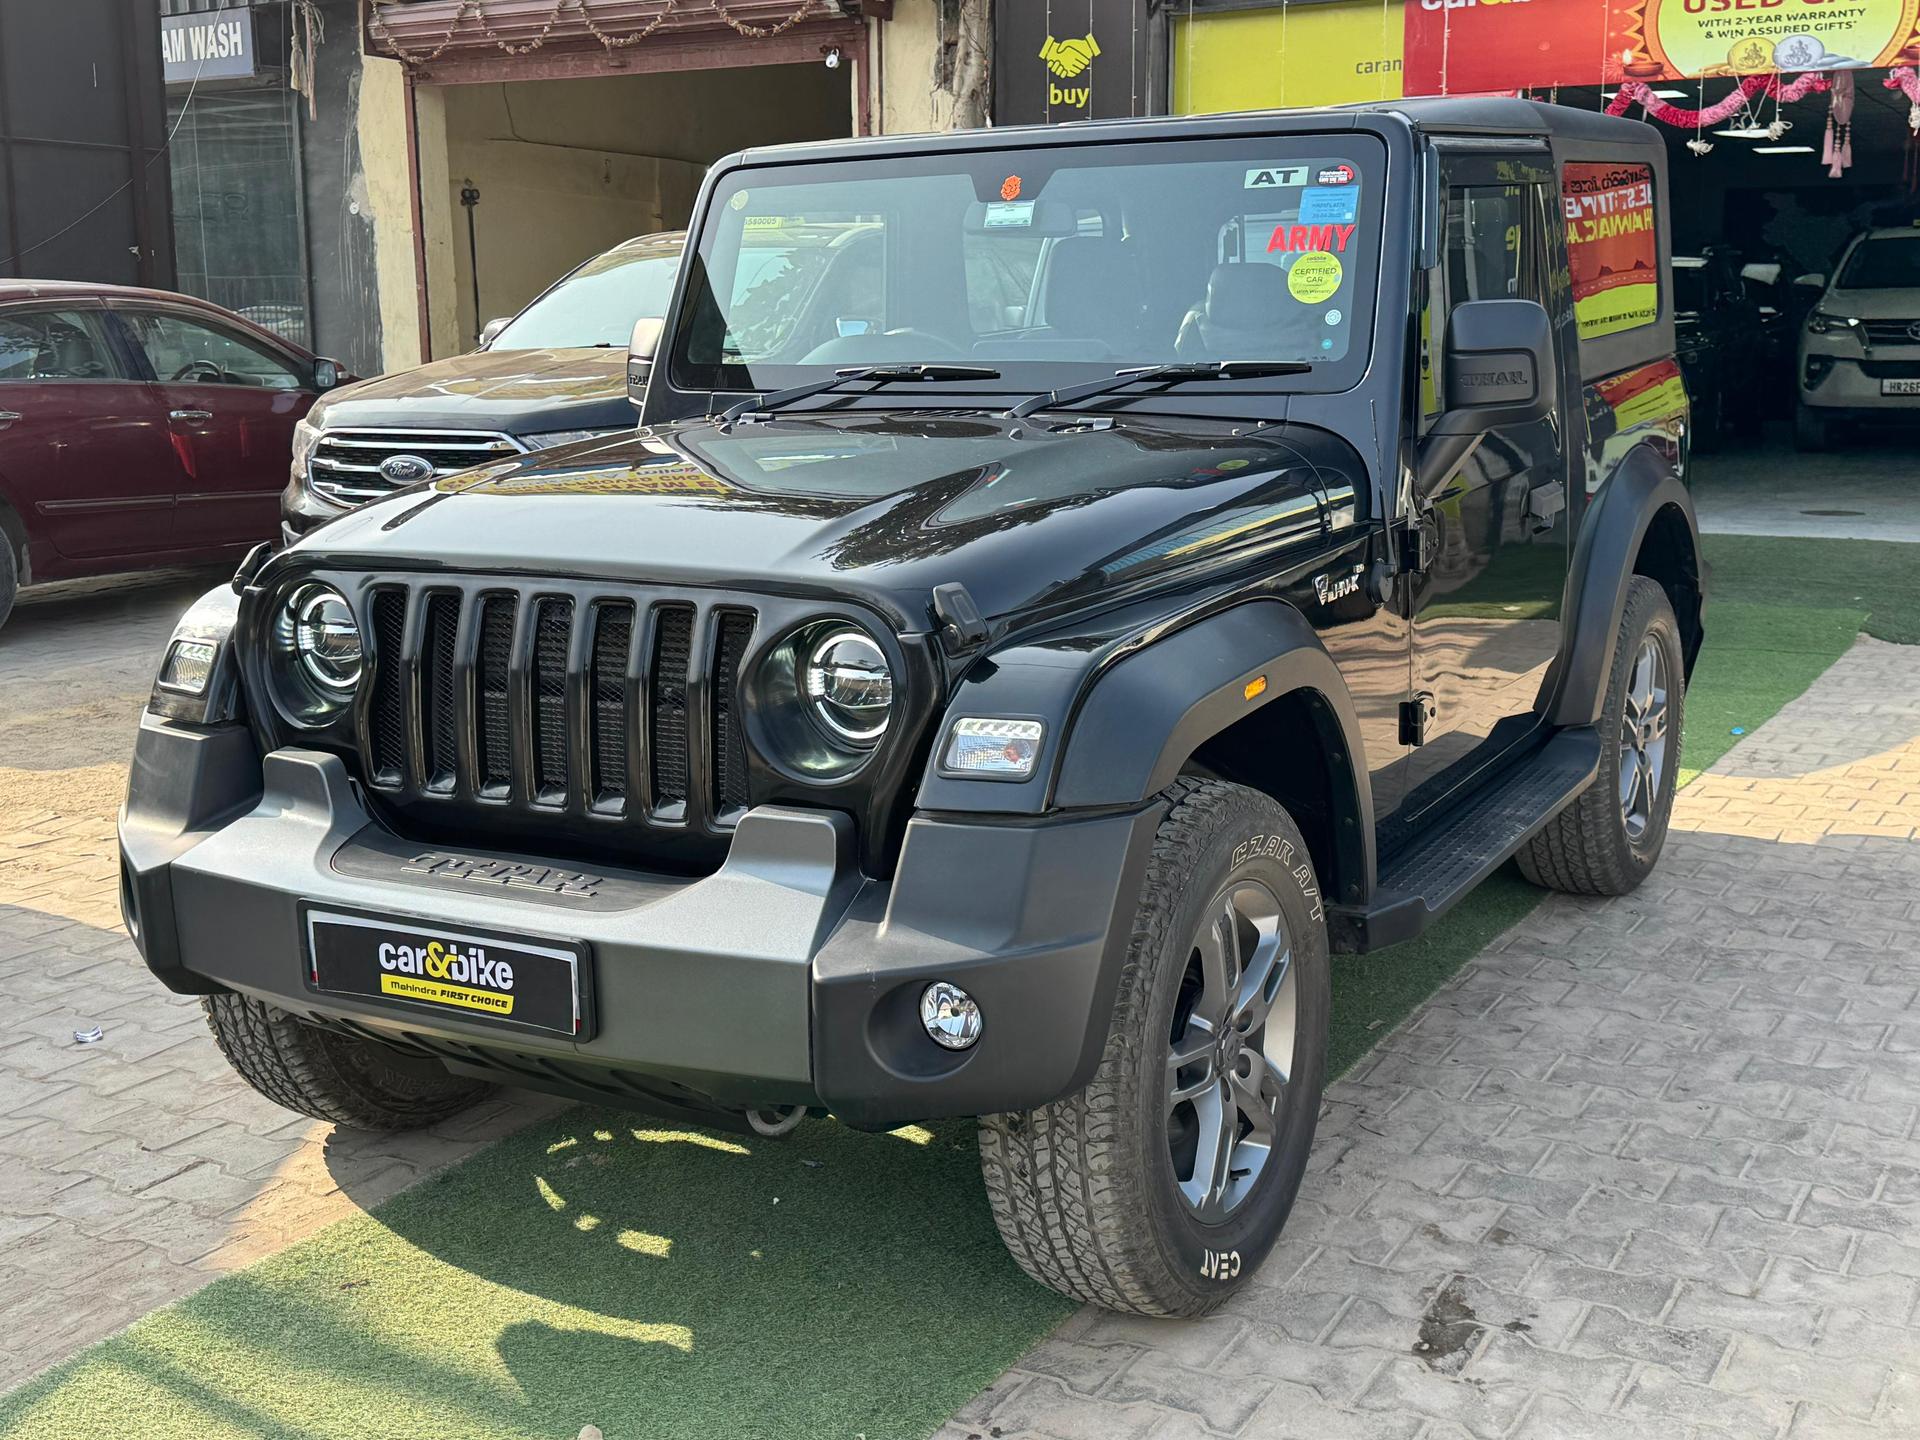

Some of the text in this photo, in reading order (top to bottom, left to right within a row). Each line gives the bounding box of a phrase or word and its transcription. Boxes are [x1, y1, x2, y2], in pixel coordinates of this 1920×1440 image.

[1697, 7, 1867, 28] WITH 2-YEAR WARRANTY
[161, 21, 243, 63] AM WASH
[1705, 30, 1714, 39] &
[1717, 29, 1744, 39] WIN
[1747, 24, 1811, 37] ASSURED
[1049, 83, 1090, 109] buy
[1250, 169, 1300, 186] AT
[1266, 223, 1357, 254] ARMY
[1294, 267, 1337, 276] CERTIFIED
[1306, 276, 1323, 284] CAR
[389, 461, 417, 477] Ford
[1229, 833, 1296, 873] CZAR
[378, 940, 515, 991] car&bike
[390, 980, 509, 1009] Mahindra FIRST CHOICE
[1199, 1248, 1242, 1281] CEAT
